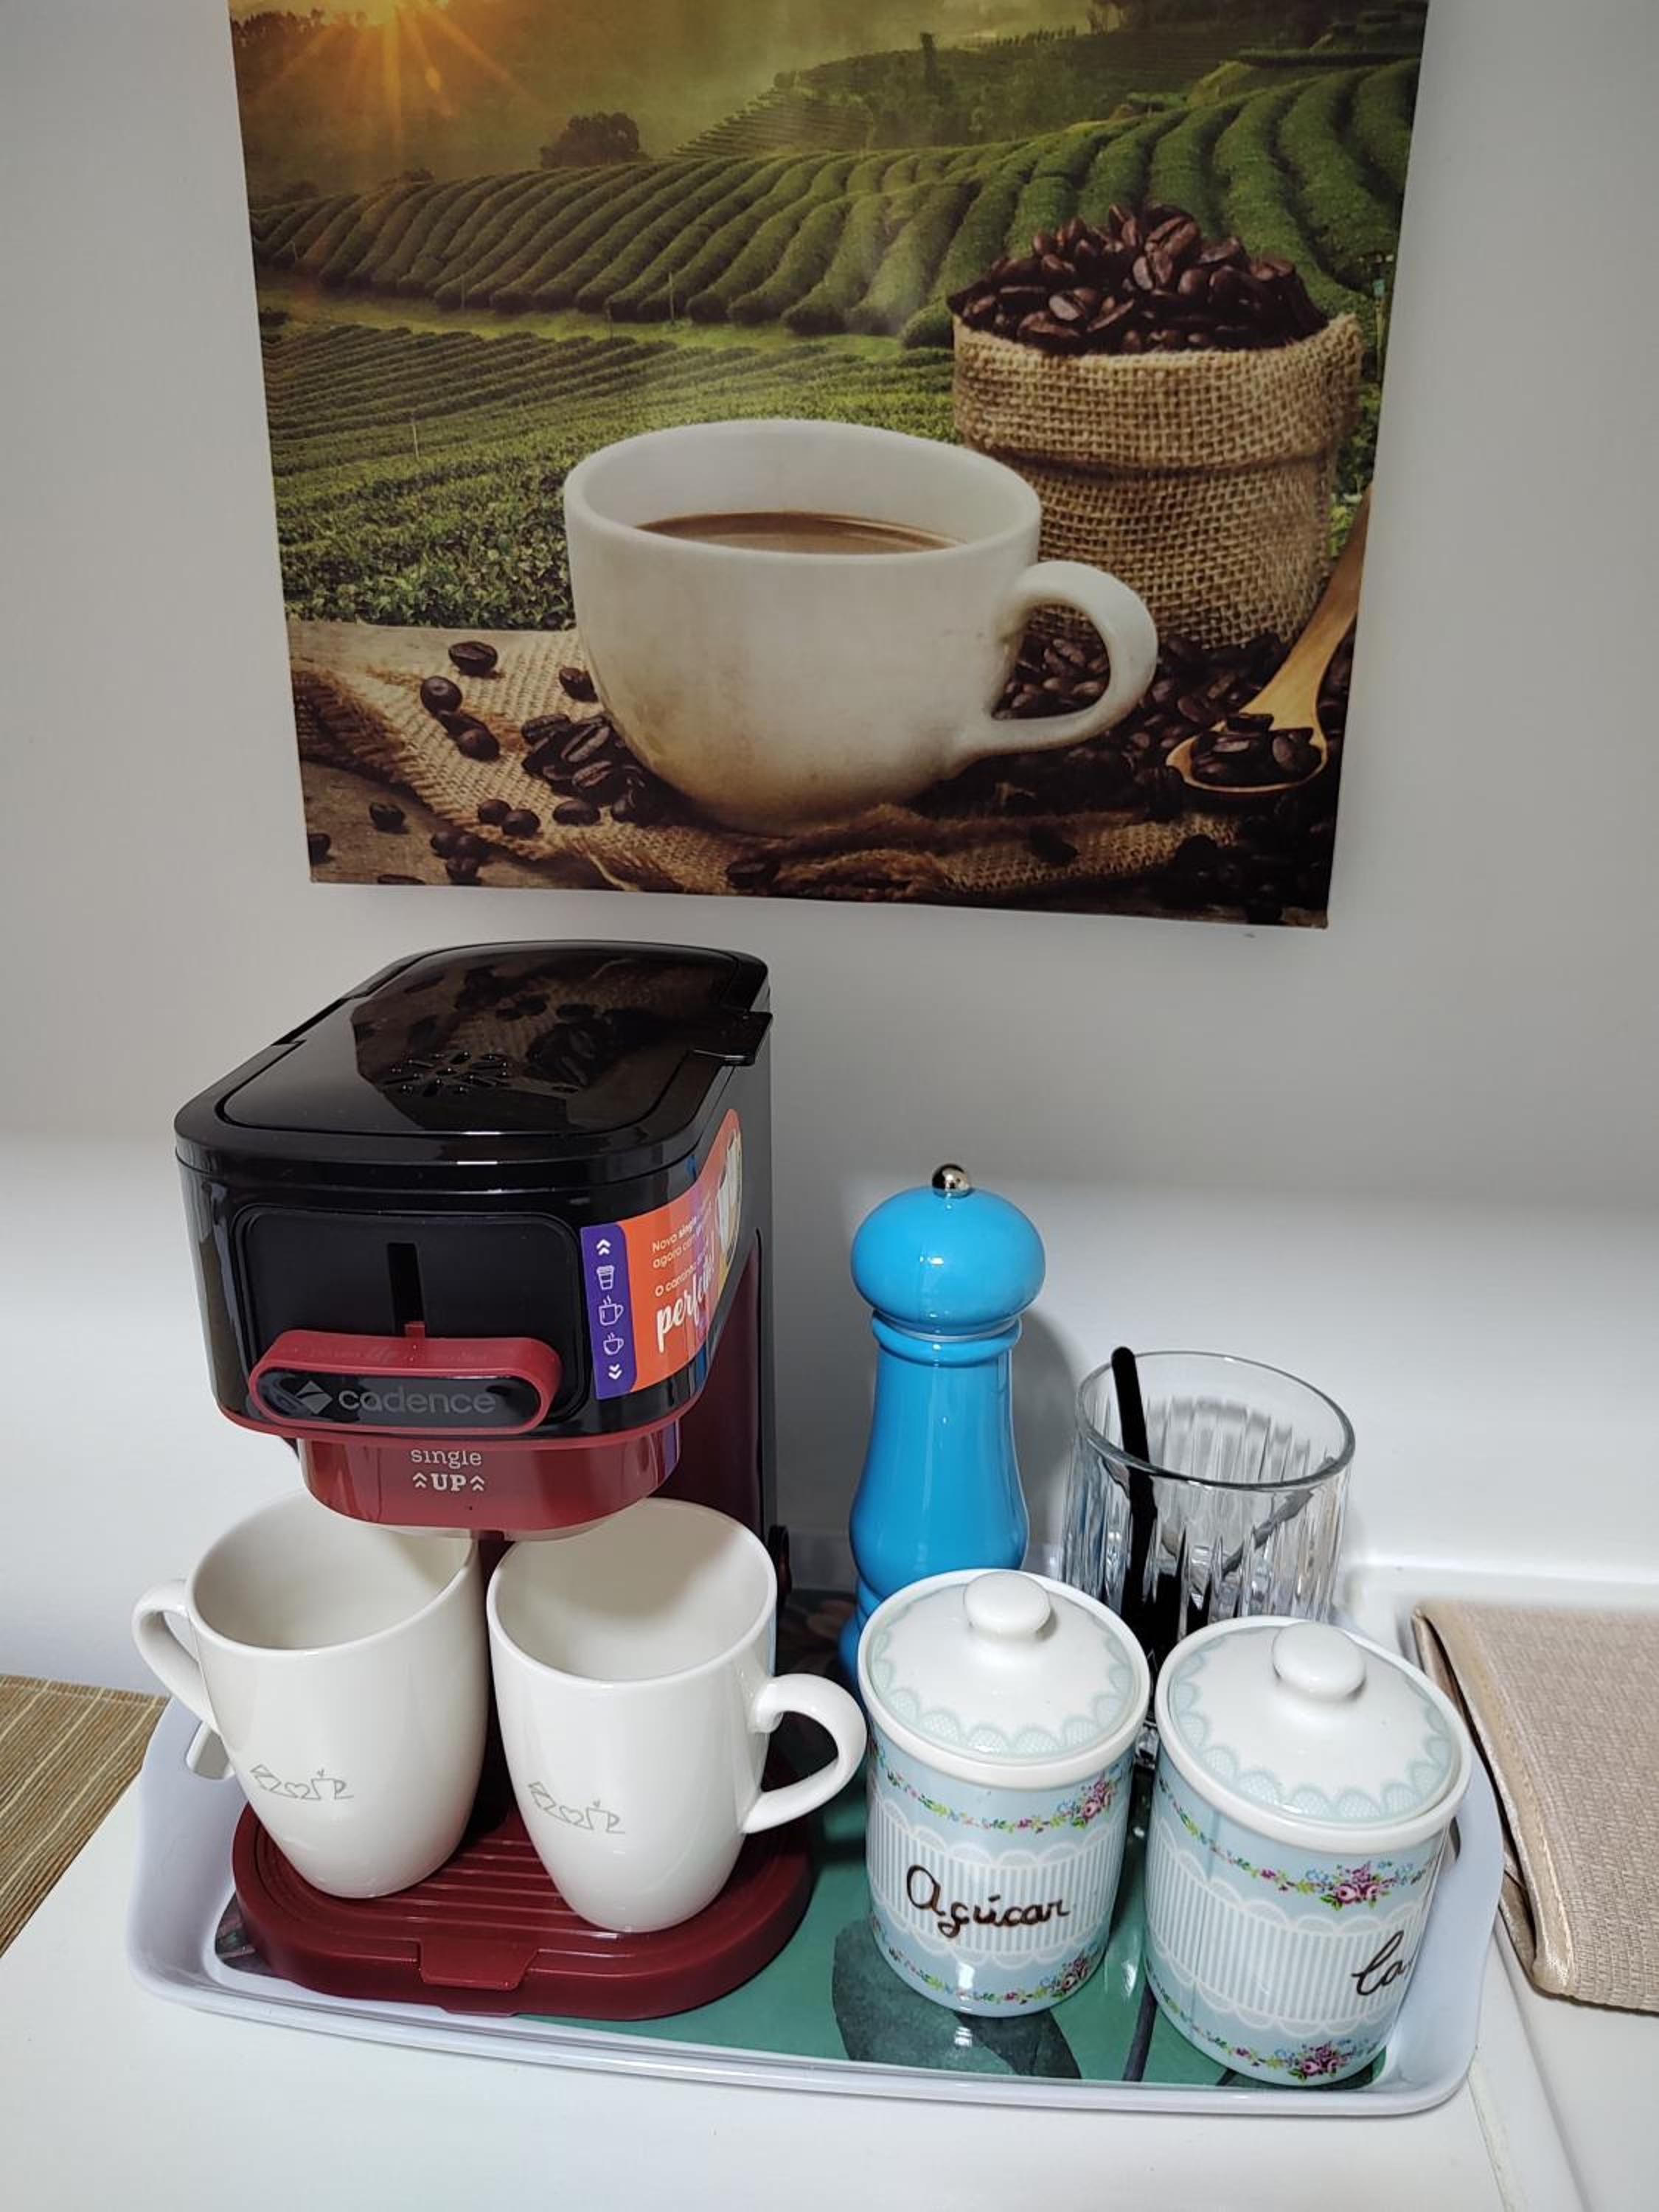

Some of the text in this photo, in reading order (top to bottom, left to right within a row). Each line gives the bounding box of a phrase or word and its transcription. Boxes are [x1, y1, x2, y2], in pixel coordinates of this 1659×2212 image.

[653, 1233, 678, 1253] Novo
[653, 1246, 682, 1269] agora
[655, 1284, 664, 1297] O
[338, 1385, 496, 1414] cadence
[411, 1447, 483, 1469] single
[431, 1473, 467, 1492] UP
